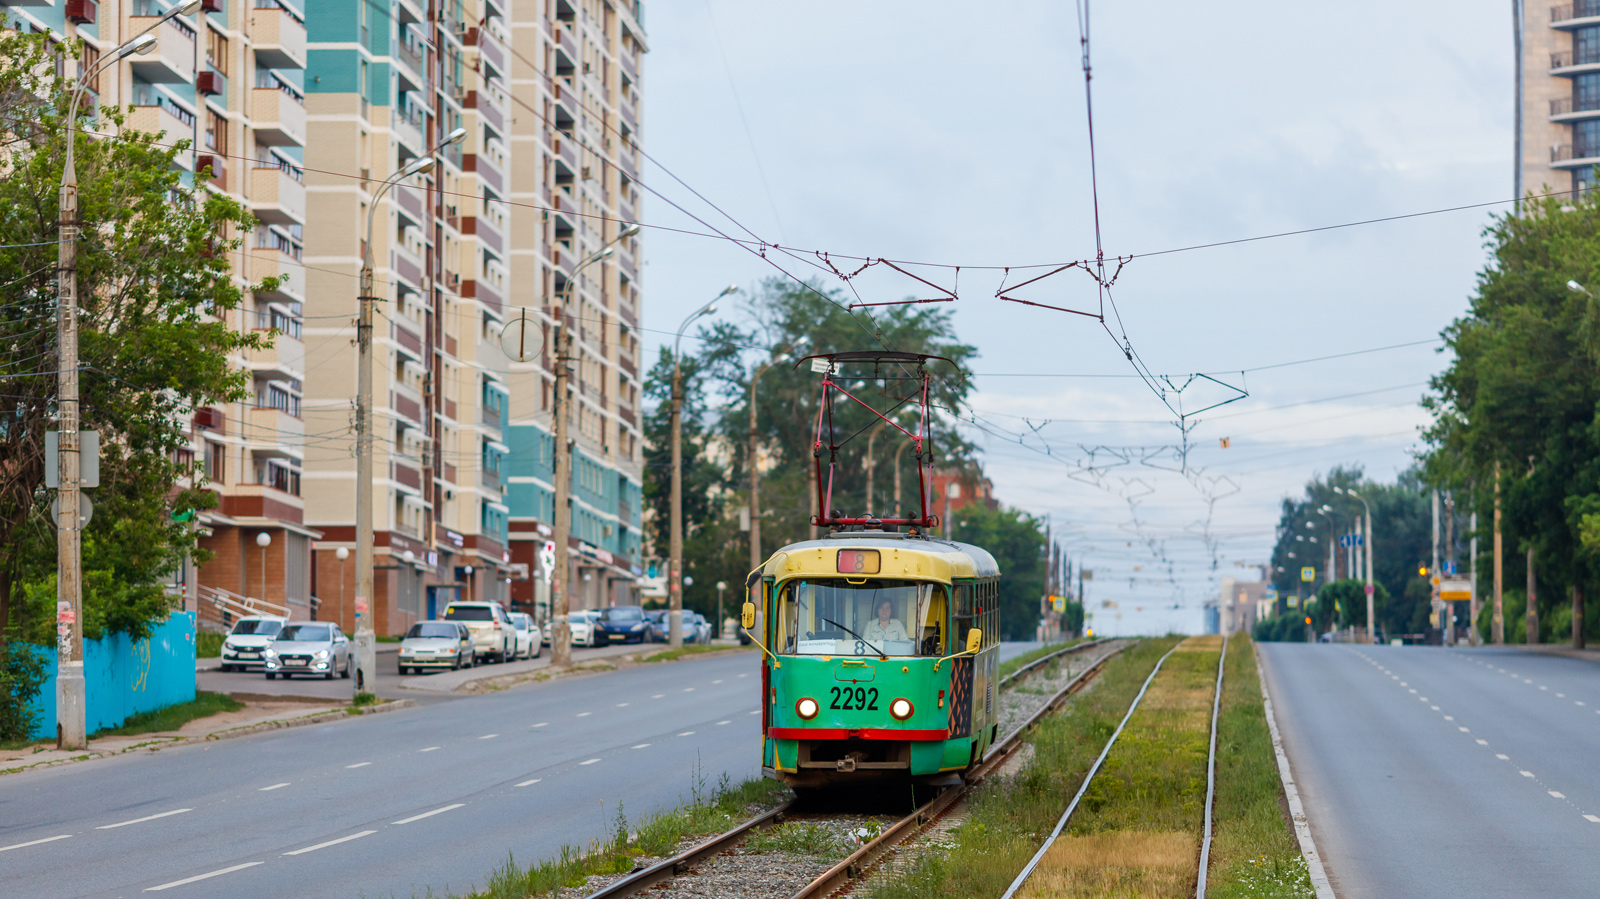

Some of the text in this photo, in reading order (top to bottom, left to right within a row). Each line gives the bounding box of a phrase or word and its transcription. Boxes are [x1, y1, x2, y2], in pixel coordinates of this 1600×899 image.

[854, 553, 865, 571] 8
[854, 640, 865, 655] 8
[829, 686, 879, 711] 2292
